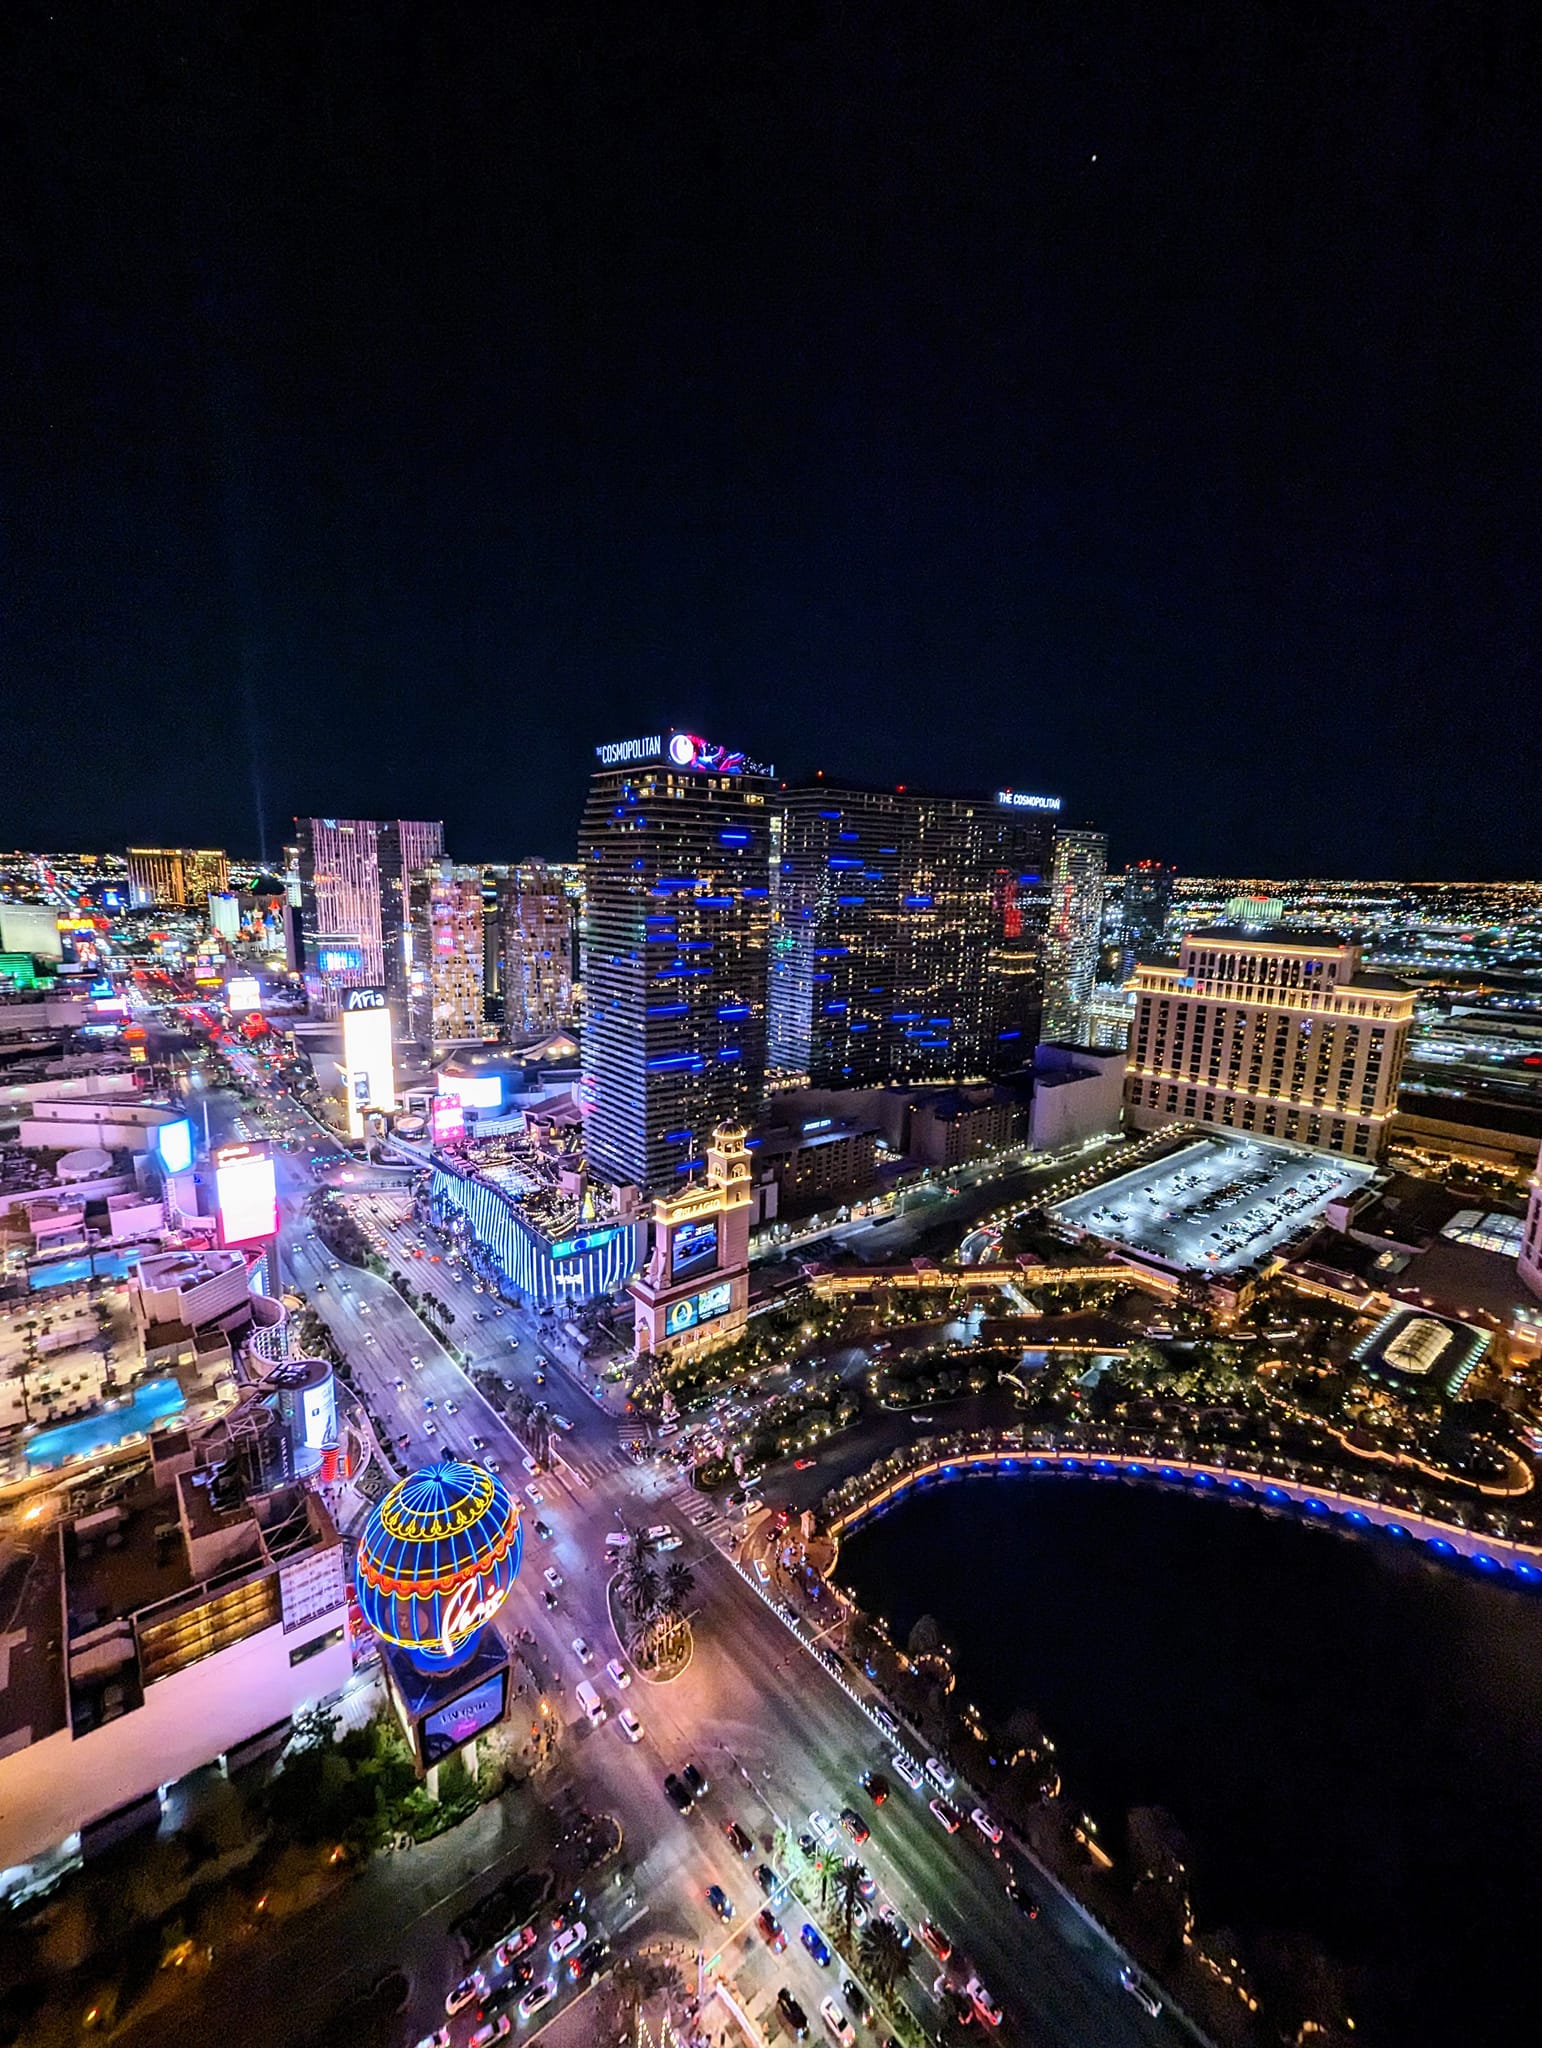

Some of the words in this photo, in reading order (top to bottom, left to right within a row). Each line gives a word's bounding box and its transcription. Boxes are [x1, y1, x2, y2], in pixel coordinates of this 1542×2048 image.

[602, 735, 661, 764] COSMOPOLITAN
[999, 792, 1012, 804] THE
[1013, 794, 1061, 810] COSMOPOLITAN
[349, 989, 385, 1010] Aria
[441, 1577, 505, 1657] Paris
